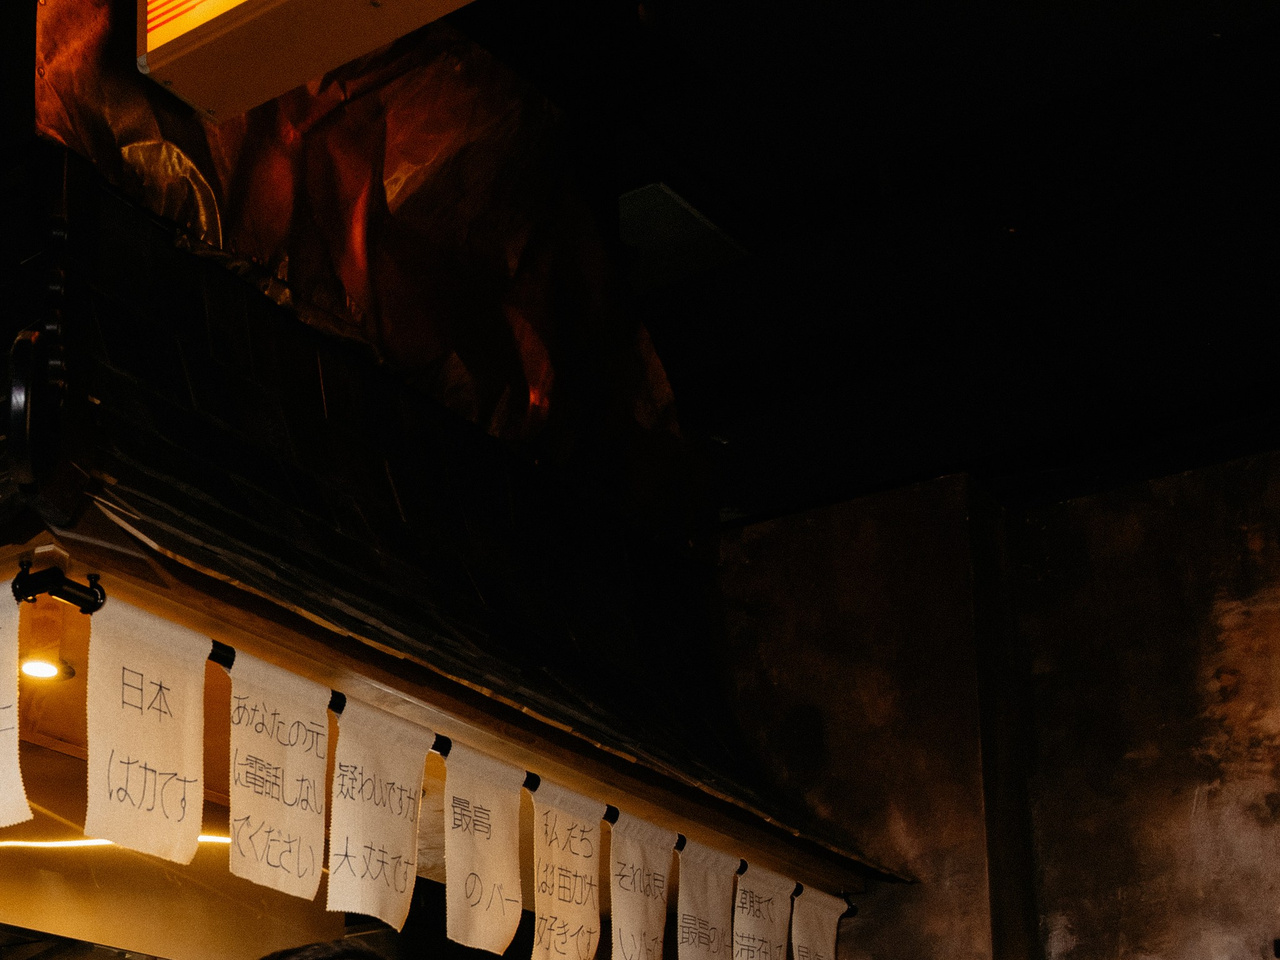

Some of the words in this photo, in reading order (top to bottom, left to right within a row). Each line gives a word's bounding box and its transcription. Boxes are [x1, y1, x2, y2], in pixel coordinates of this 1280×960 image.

[121, 666, 173, 722] 日本
[231, 694, 325, 760] あなたの元
[451, 795, 492, 840] 最高
[543, 809, 594, 858] 私たち
[231, 815, 316, 878] でください
[333, 836, 414, 894] 大丈夫です
[464, 872, 519, 916] のバー
